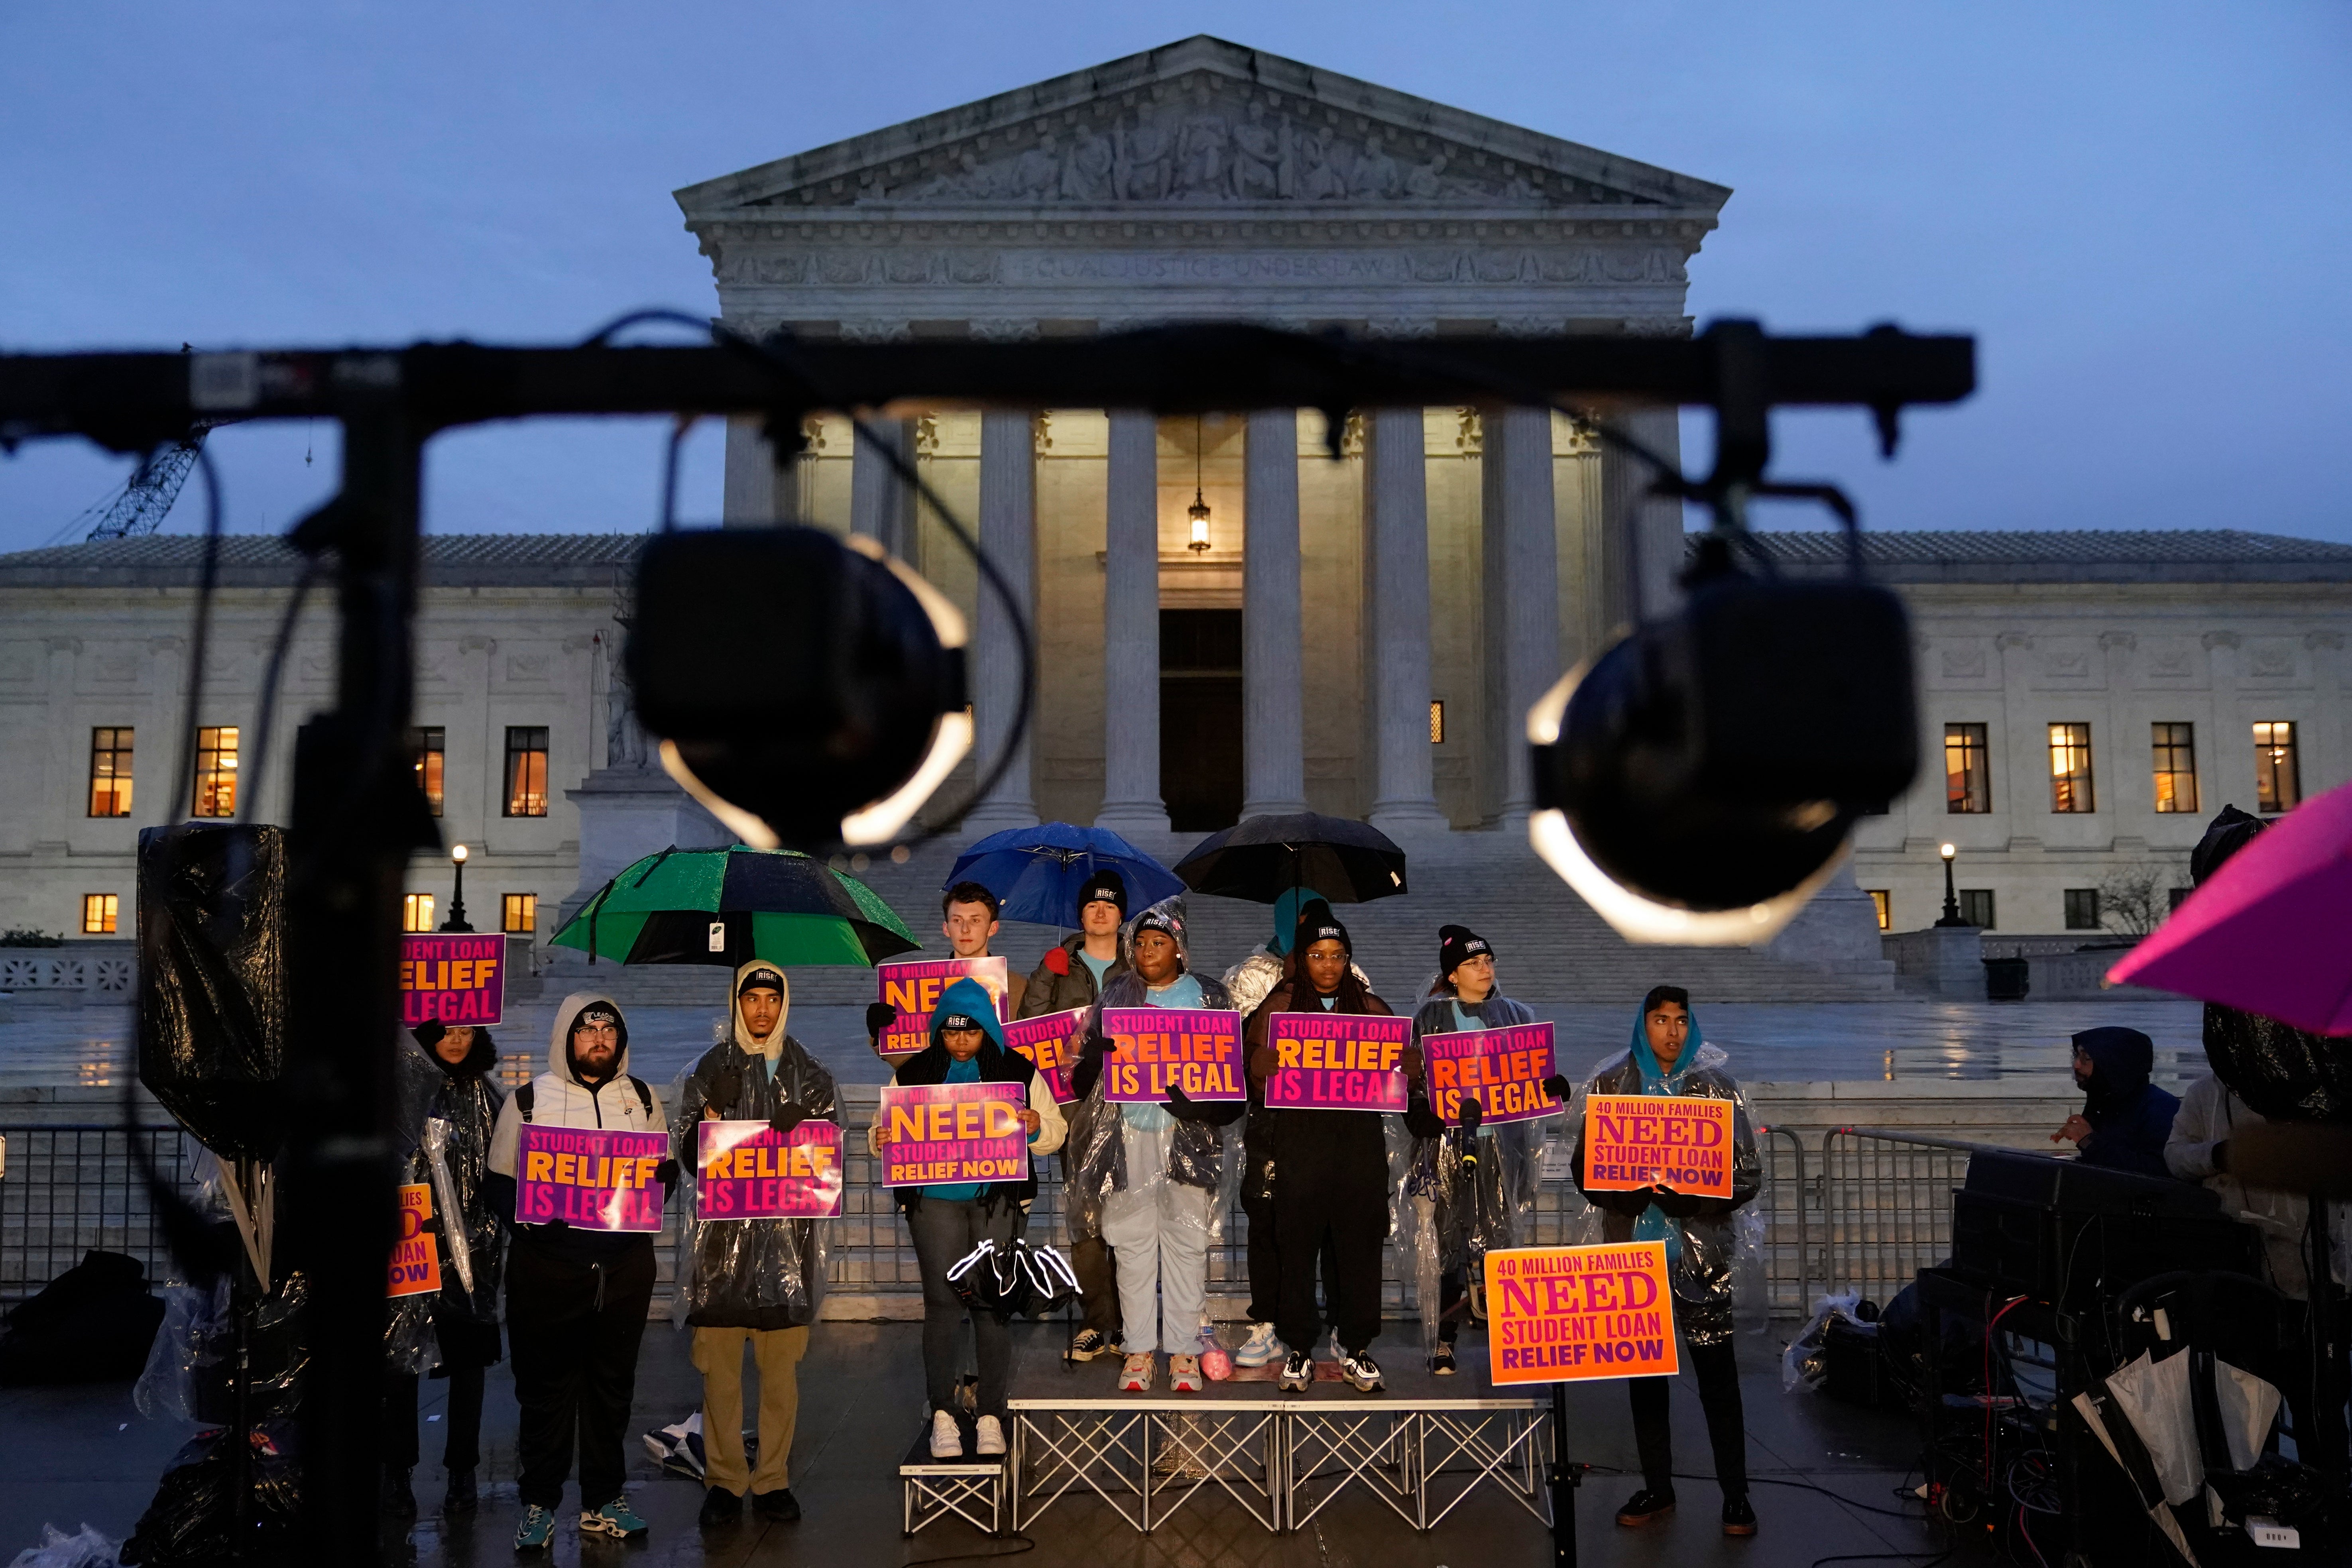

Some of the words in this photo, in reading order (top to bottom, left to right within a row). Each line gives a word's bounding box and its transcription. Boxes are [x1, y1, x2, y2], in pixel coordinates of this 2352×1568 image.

[1022, 258, 1104, 277] EQUAL
[1119, 258, 1221, 277] JUSTICE
[1236, 258, 1319, 277] UNDER
[1335, 258, 1384, 277] LAW
[401, 941, 444, 959] DENT
[450, 941, 495, 959] LOAN
[1467, 941, 1484, 950] RISE
[400, 959, 497, 990] ELIEF
[759, 972, 775, 980] RISE
[885, 967, 897, 979] 40
[902, 963, 945, 979] MILLION
[404, 990, 495, 1022] LEGAL
[948, 1017, 966, 1026] RISE
[1008, 1018, 1072, 1046] STUDENT
[1111, 1015, 1184, 1032] STUDENT
[1190, 1016, 1232, 1034] LOAN
[1278, 1020, 1353, 1039] STUDENT
[1359, 1022, 1402, 1041] LOAN
[887, 1032, 930, 1049] RELI
[1111, 1033, 1234, 1063] RELIEF
[1432, 1035, 1502, 1058] STUDENT
[1507, 1030, 1546, 1051] LOAN
[1276, 1039, 1403, 1070] RELIEF
[1111, 1064, 1139, 1094] IS
[1150, 1063, 1239, 1094] LEGAL
[1433, 1048, 1548, 1088] RELIEF
[889, 1091, 905, 1104] 40
[963, 1086, 1017, 1101] FAMILIES
[1274, 1070, 1301, 1100] IS
[1313, 1071, 1401, 1103] LEGAL
[1436, 1089, 1461, 1120] IS
[1596, 1102, 1611, 1113] 40
[1616, 1102, 1664, 1115] MILLION
[1669, 1104, 1723, 1118] FAMILIES
[891, 1101, 1018, 1143] NEED
[1595, 1115, 1723, 1147] NEED
[529, 1131, 607, 1155] STUDENT
[613, 1137, 659, 1156] LOAN
[790, 1127, 833, 1146] LOAN
[706, 1147, 835, 1179] RELIEF
[891, 1142, 967, 1163] STUDENT
[973, 1139, 1017, 1159] LOAN
[1595, 1145, 1671, 1165] STUDENT
[1678, 1148, 1722, 1168] LOAN
[527, 1151, 659, 1189] RELIEF
[891, 1162, 958, 1181] RELIEF
[963, 1159, 1019, 1177] NOW
[1593, 1165, 1661, 1182] RELIEF
[1666, 1167, 1723, 1186] NOW
[524, 1183, 554, 1216] IS
[705, 1181, 734, 1212] IS
[391, 1241, 427, 1264] OAN
[1497, 1260, 1516, 1276] 40
[1522, 1256, 1582, 1275] MILLION
[1587, 1251, 1654, 1271] FAMILIES
[390, 1263, 428, 1284] OW
[1498, 1271, 1657, 1318] NEED
[1502, 1316, 1597, 1345] STUDENT
[1605, 1312, 1661, 1338] LOAN
[1502, 1344, 1587, 1370] RELIEF
[1593, 1339, 1664, 1364] NOW
